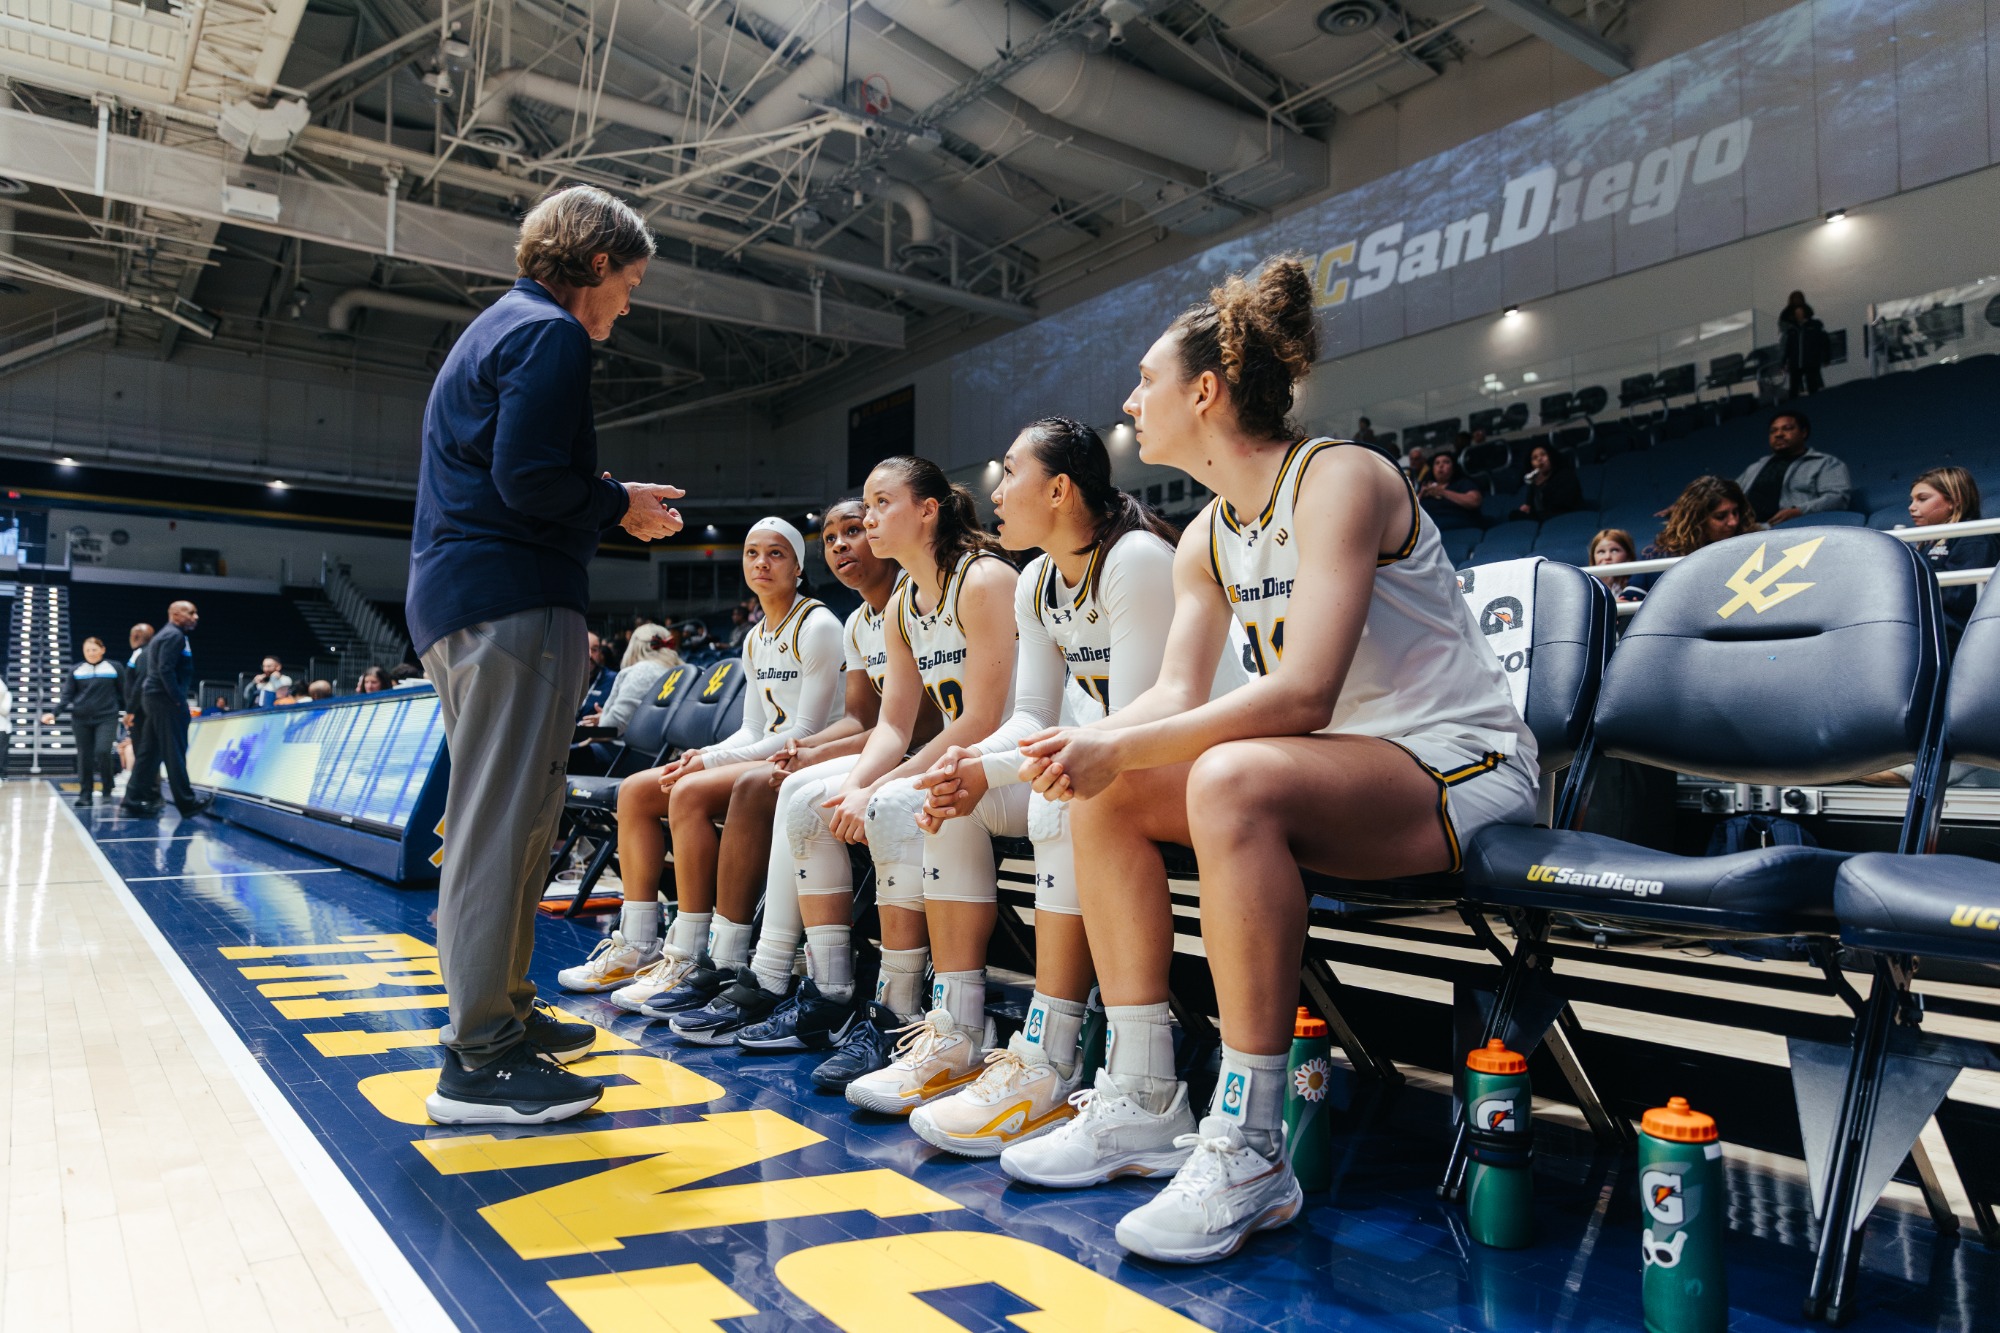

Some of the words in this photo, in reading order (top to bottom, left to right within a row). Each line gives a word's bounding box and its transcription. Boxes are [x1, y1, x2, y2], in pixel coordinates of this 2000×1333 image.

[1301, 118, 1752, 308] CSanDiego
[1527, 864, 1665, 897] UCSanDiego
[1476, 1099, 1515, 1132] G
[1642, 1170, 1684, 1225] G
